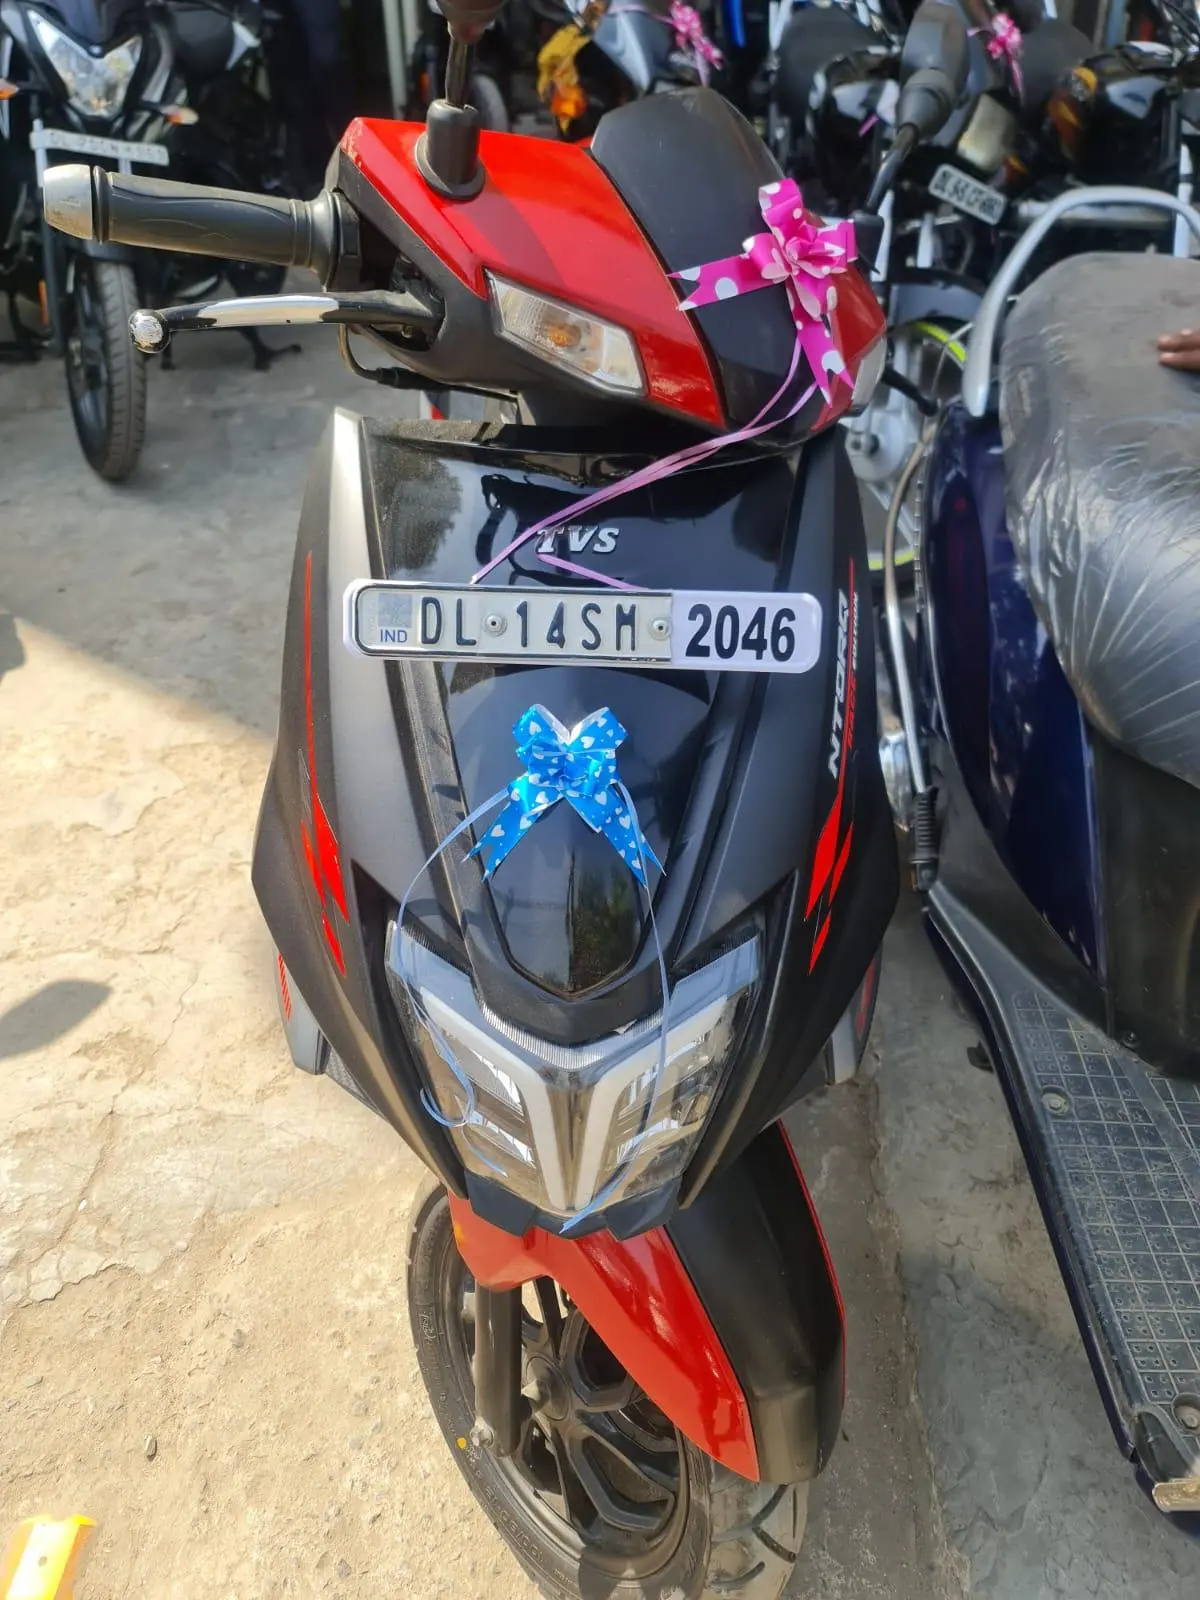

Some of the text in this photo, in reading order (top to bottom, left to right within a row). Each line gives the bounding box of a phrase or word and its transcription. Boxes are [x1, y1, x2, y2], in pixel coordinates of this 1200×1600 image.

[537, 524, 619, 553] TVS
[380, 629, 407, 643] IND
[421, 597, 477, 645] DL
[685, 603, 797, 662] 2046
[828, 588, 848, 779] NTORQ
